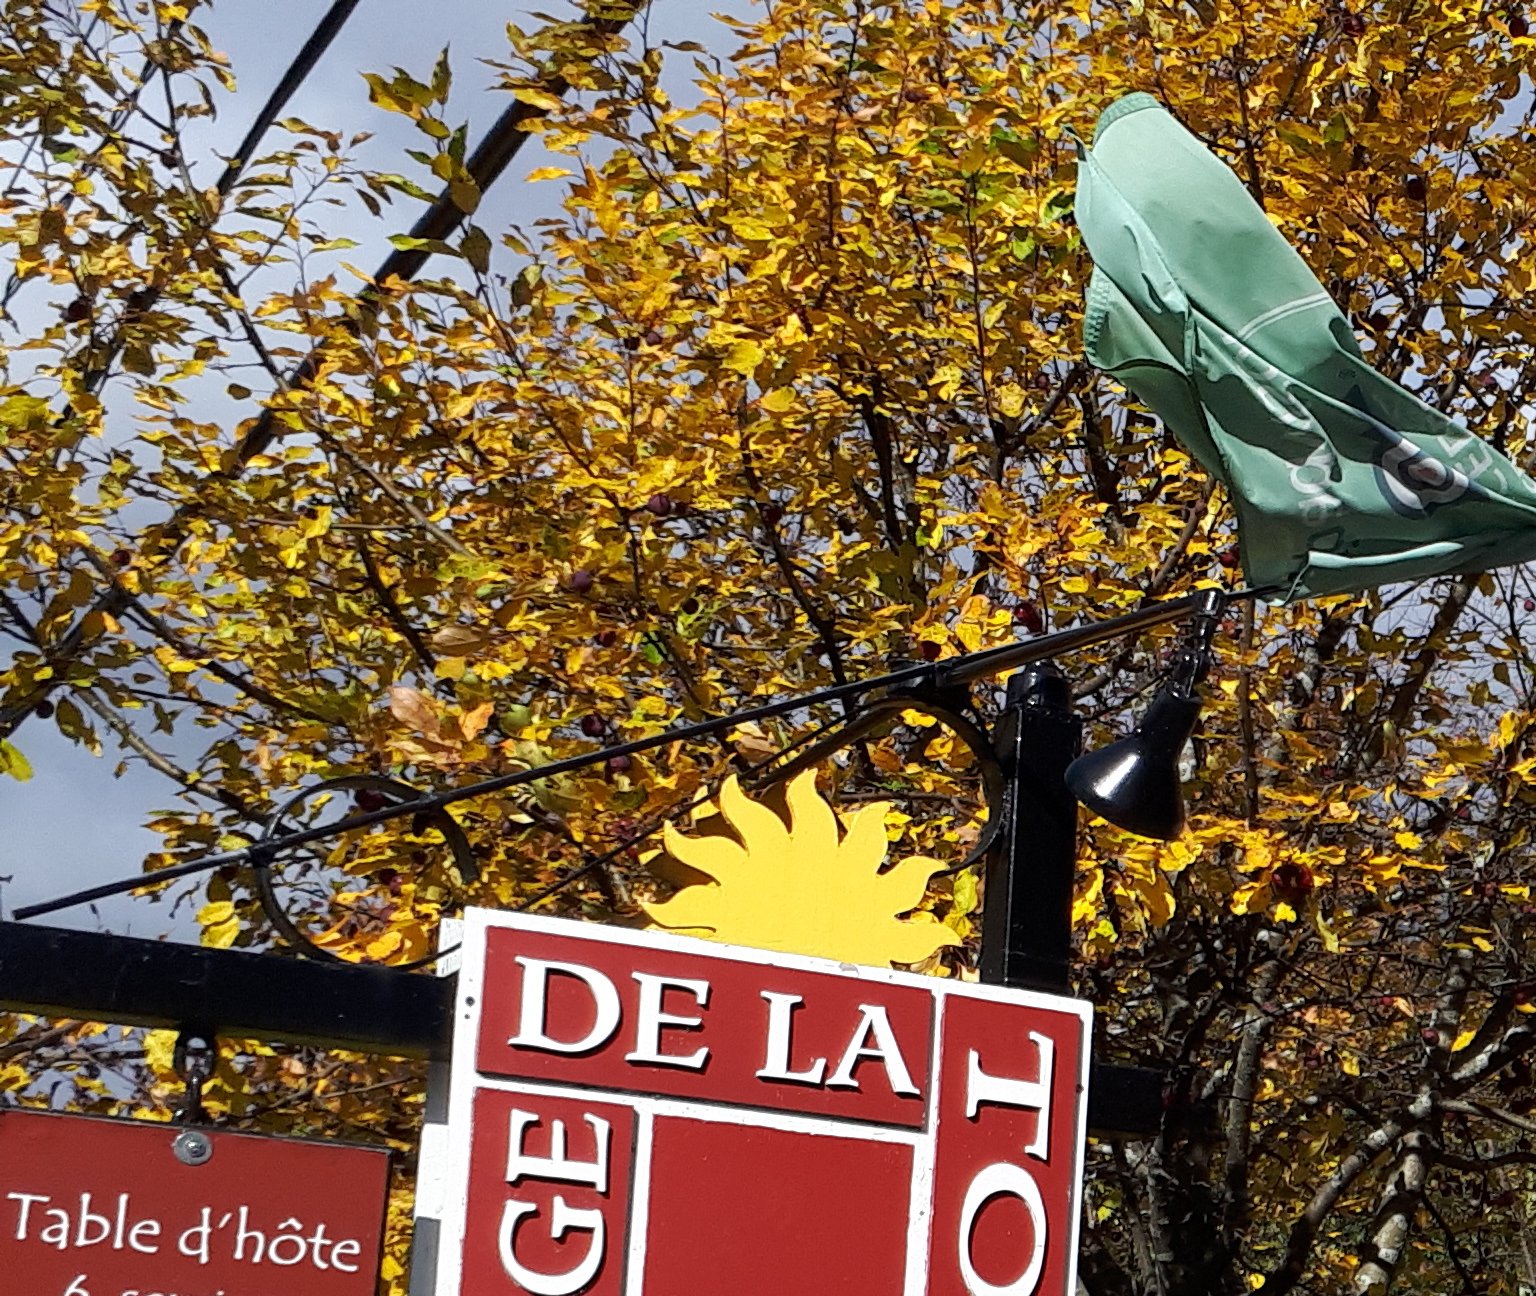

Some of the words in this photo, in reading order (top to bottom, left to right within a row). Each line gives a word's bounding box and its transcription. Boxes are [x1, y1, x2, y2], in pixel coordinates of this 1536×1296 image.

[507, 955, 710, 1069] DE
[755, 989, 921, 1095] LA
[7, 1192, 162, 1254] Table
[178, 1205, 362, 1273] d'hôte
